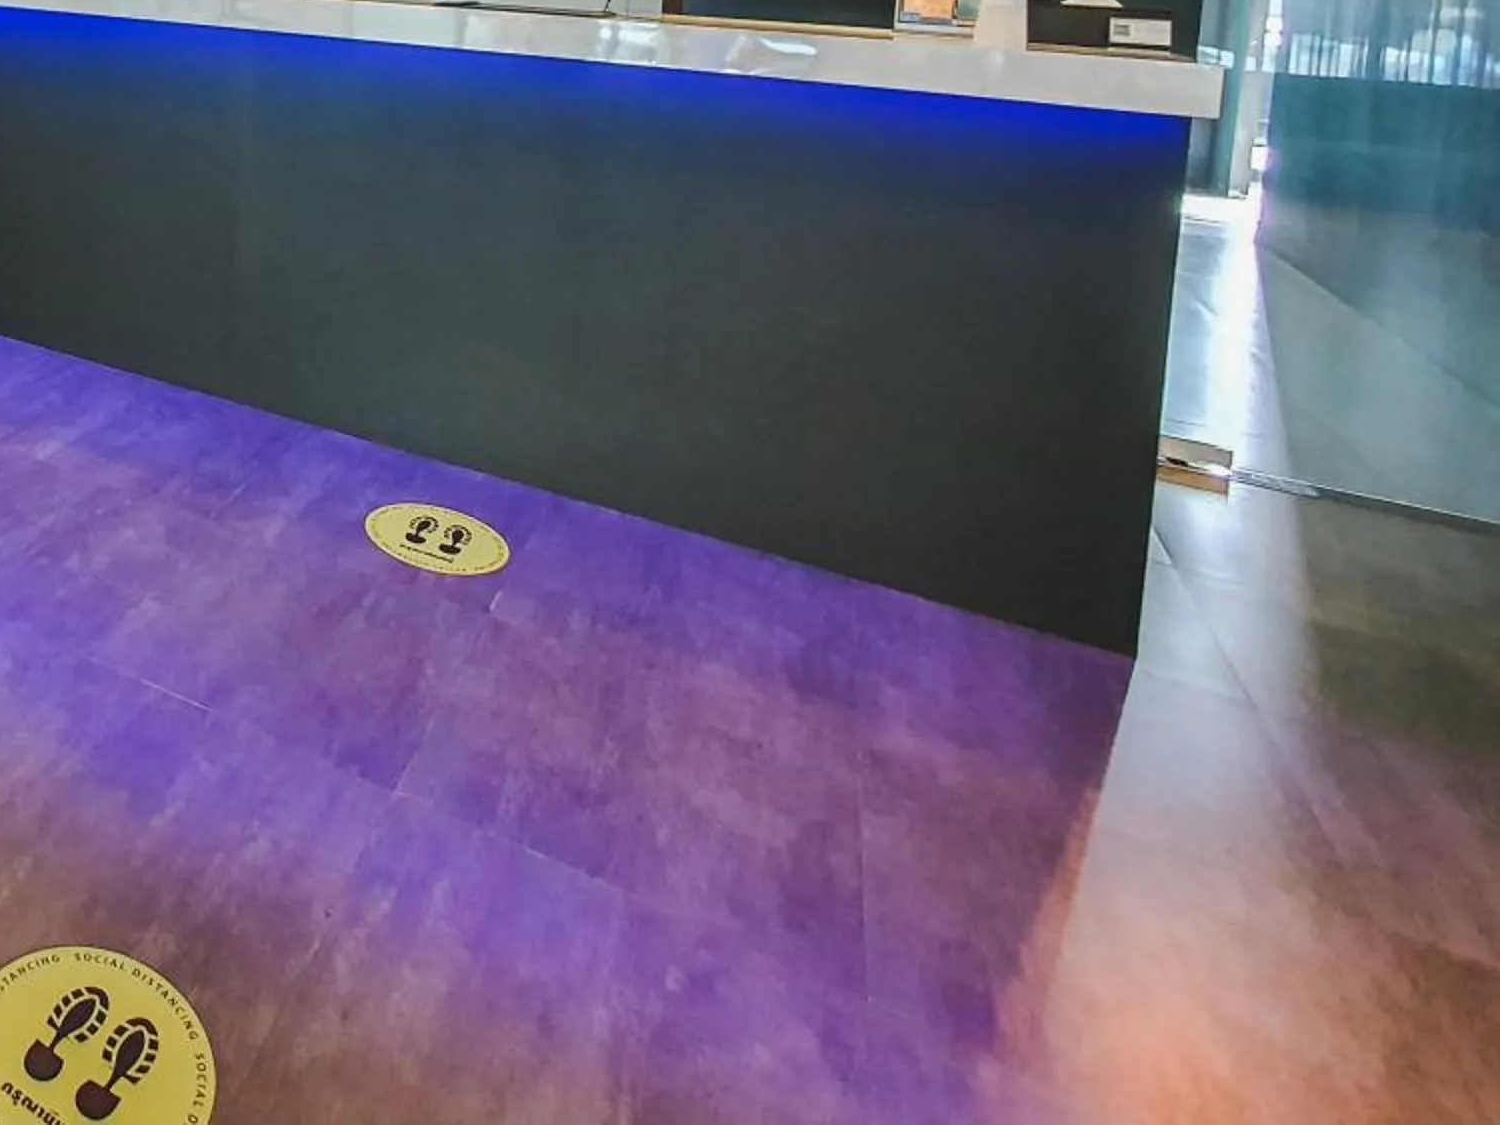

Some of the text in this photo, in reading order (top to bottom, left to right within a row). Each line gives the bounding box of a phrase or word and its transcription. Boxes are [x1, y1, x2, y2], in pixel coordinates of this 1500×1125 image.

[74, 952, 126, 971] SOCIAL
[131, 968, 200, 1040] DISTANCING
[192, 1053, 208, 1107] SOCIAL
